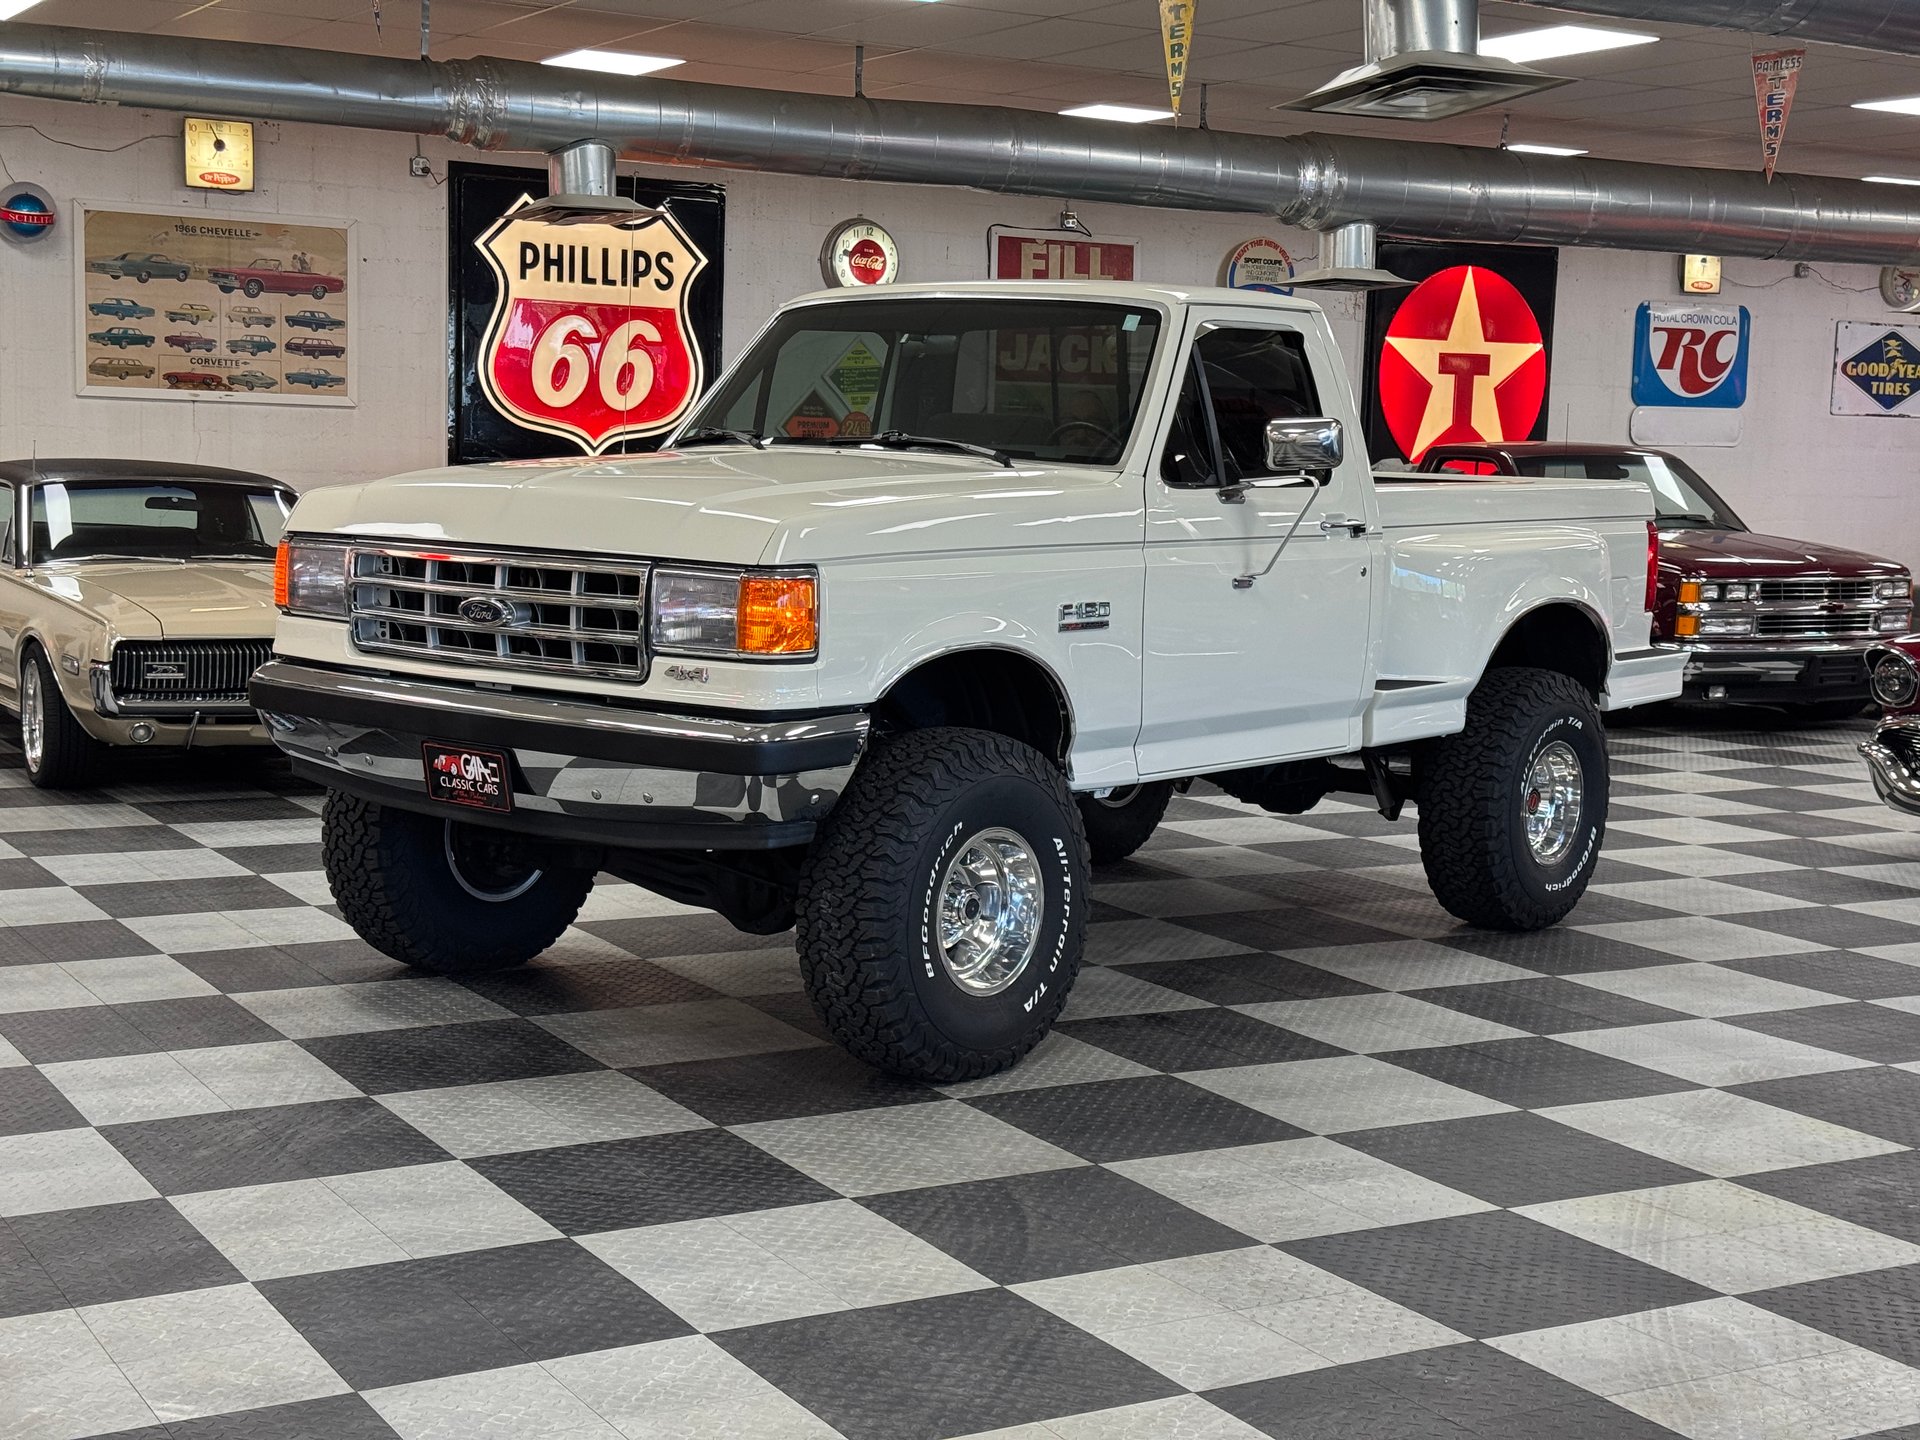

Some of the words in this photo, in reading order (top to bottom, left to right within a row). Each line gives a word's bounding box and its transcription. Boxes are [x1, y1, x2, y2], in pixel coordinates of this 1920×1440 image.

[1168, 4, 1187, 97] TERMS
[1766, 76, 1787, 156] TERMS
[213, 172, 237, 184] Pepper
[174, 224, 197, 233] 1966
[199, 226, 251, 238] CHEVELLE
[519, 241, 674, 291] PHILLIPS
[1021, 242, 1113, 280] FILL
[1234, 244, 1250, 264] RENT
[1248, 239, 1264, 249] THE
[1264, 239, 1281, 251] NEW
[1278, 246, 1292, 268] VEGA
[1263, 258, 1283, 266] COUPE
[1680, 314, 1712, 324] CROWN
[1713, 315, 1737, 325] COLA
[190, 357, 240, 367] CORVETTE
[531, 314, 662, 411] 66
[1653, 327, 1736, 394] RC
[1871, 381, 1911, 396] TIRES
[469, 604, 494, 620] Ford
[1567, 716, 1583, 730] T/A
[440, 776, 475, 792] CLASSIC
[476, 782, 499, 795] CARS
[921, 821, 963, 979] BFGoodrich
[1050, 837, 1072, 973] All-Terrain
[1023, 982, 1048, 1013] T/A
